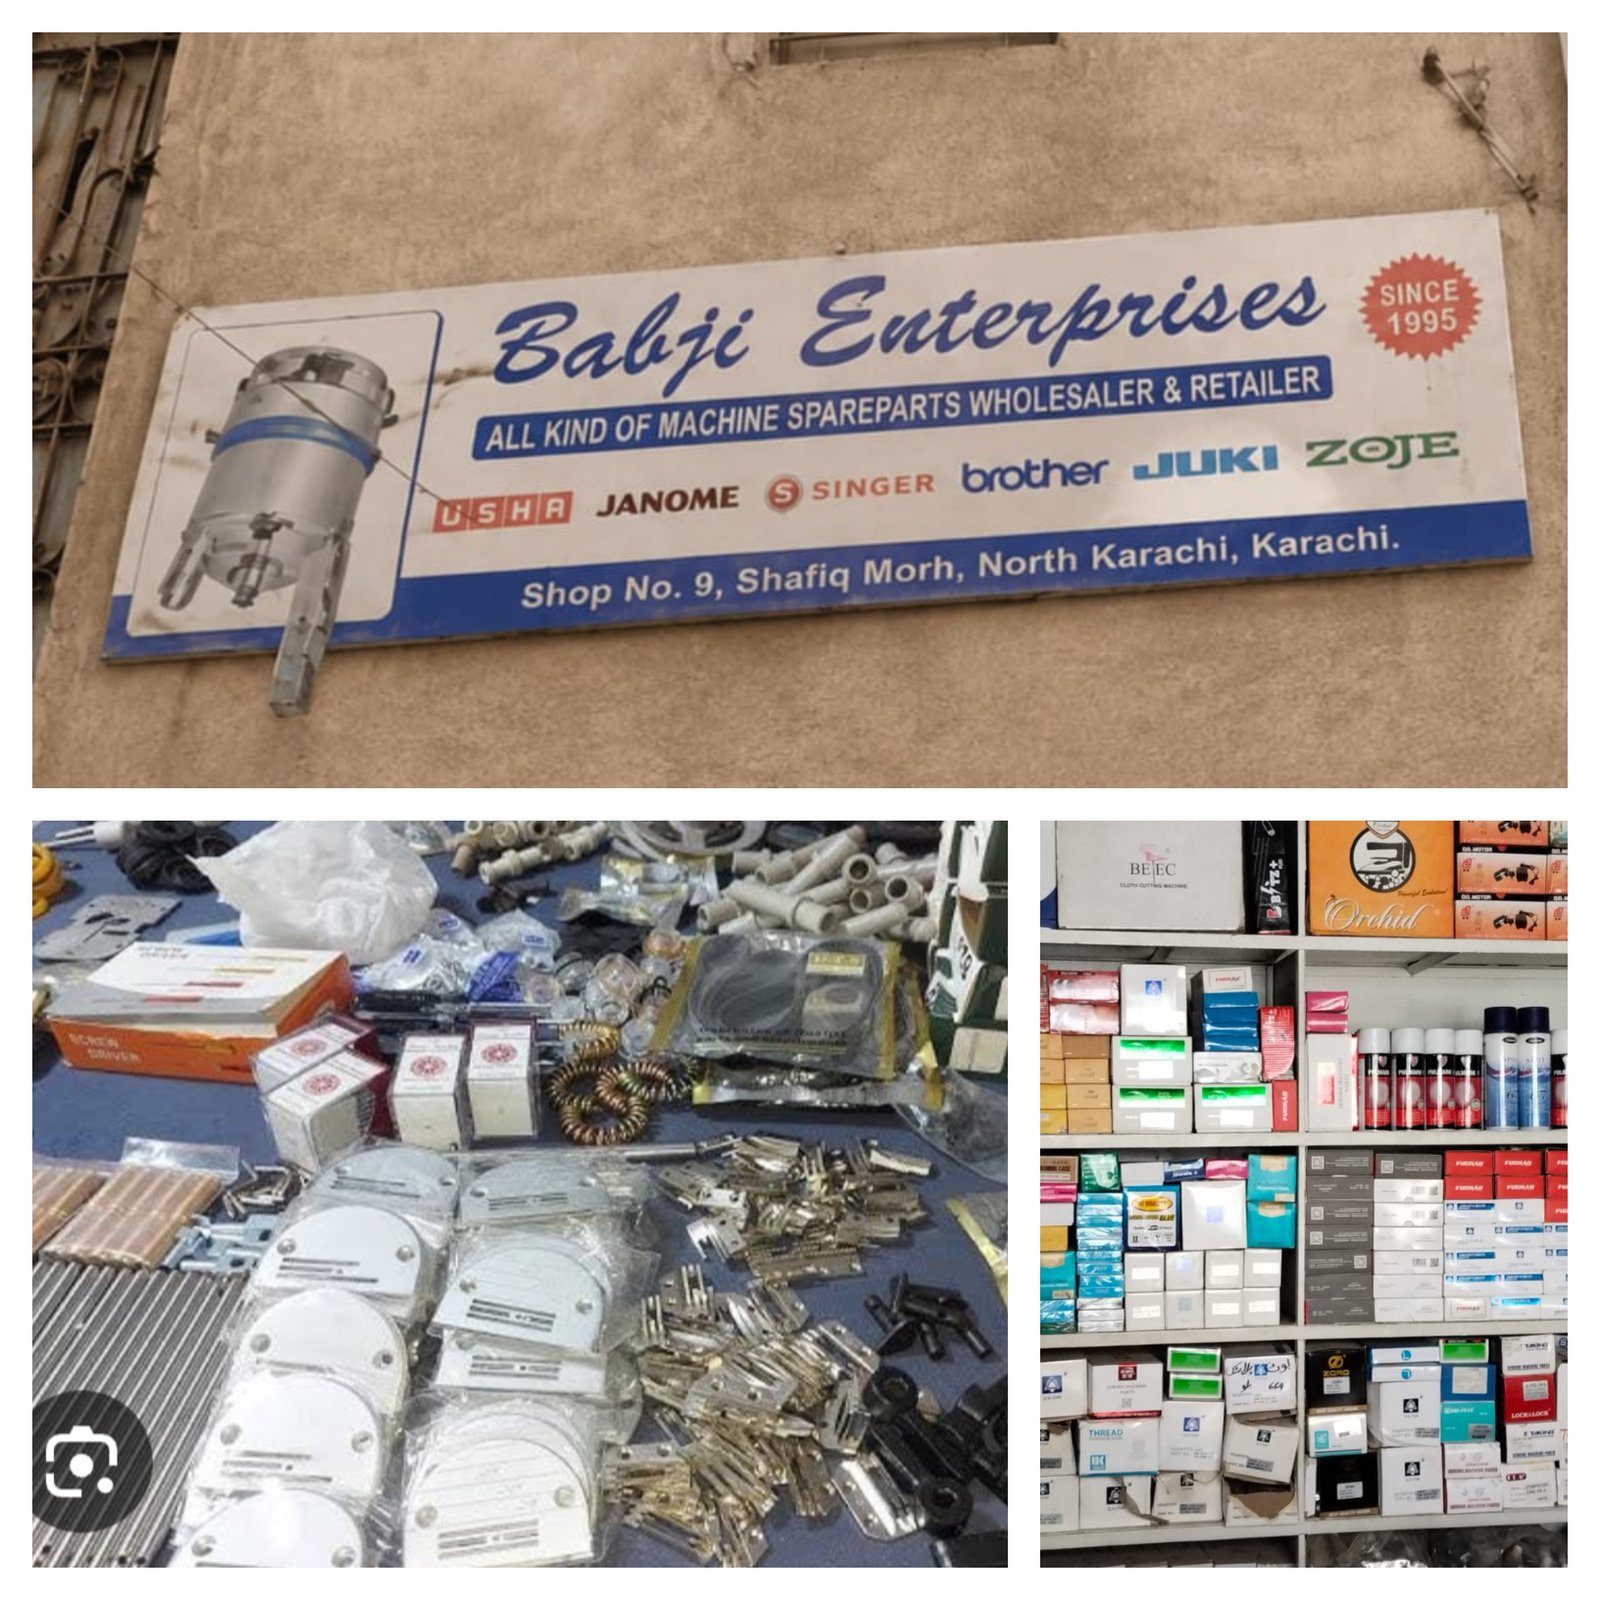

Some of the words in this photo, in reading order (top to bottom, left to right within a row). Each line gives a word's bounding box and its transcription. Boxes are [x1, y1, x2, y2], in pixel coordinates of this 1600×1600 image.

[1379, 279, 1460, 307] SINCE
[494, 292, 754, 398] Babji
[801, 275, 1327, 367] Enterprises
[1386, 309, 1458, 337] 1995
[485, 422, 535, 452] ALL
[543, 415, 606, 448] KIND
[614, 411, 652, 443] OF
[658, 402, 779, 440] MACHINE
[787, 391, 960, 429] SPAREPARTS
[970, 377, 1154, 417] WHOLESALER
[1163, 375, 1183, 404] &
[1191, 366, 1320, 400] RETAILER
[1133, 445, 1279, 480] JUKI
[1305, 431, 1460, 469] ZOJE
[812, 473, 935, 500] SINGER
[962, 458, 1109, 493] brother
[440, 494, 568, 528] USHA
[596, 486, 739, 517] JANOME
[521, 580, 611, 610] Shop
[624, 574, 681, 602] No.
[694, 571, 723, 600] 9,
[736, 562, 850, 595] Shafiq
[863, 555, 964, 583] Morh,
[977, 545, 1078, 578] North
[1091, 535, 1239, 570] Karachi,
[1251, 524, 1401, 558] Karachi.
[1324, 896, 1435, 932] Orchid
[1088, 1429, 1123, 1437] THREAD
